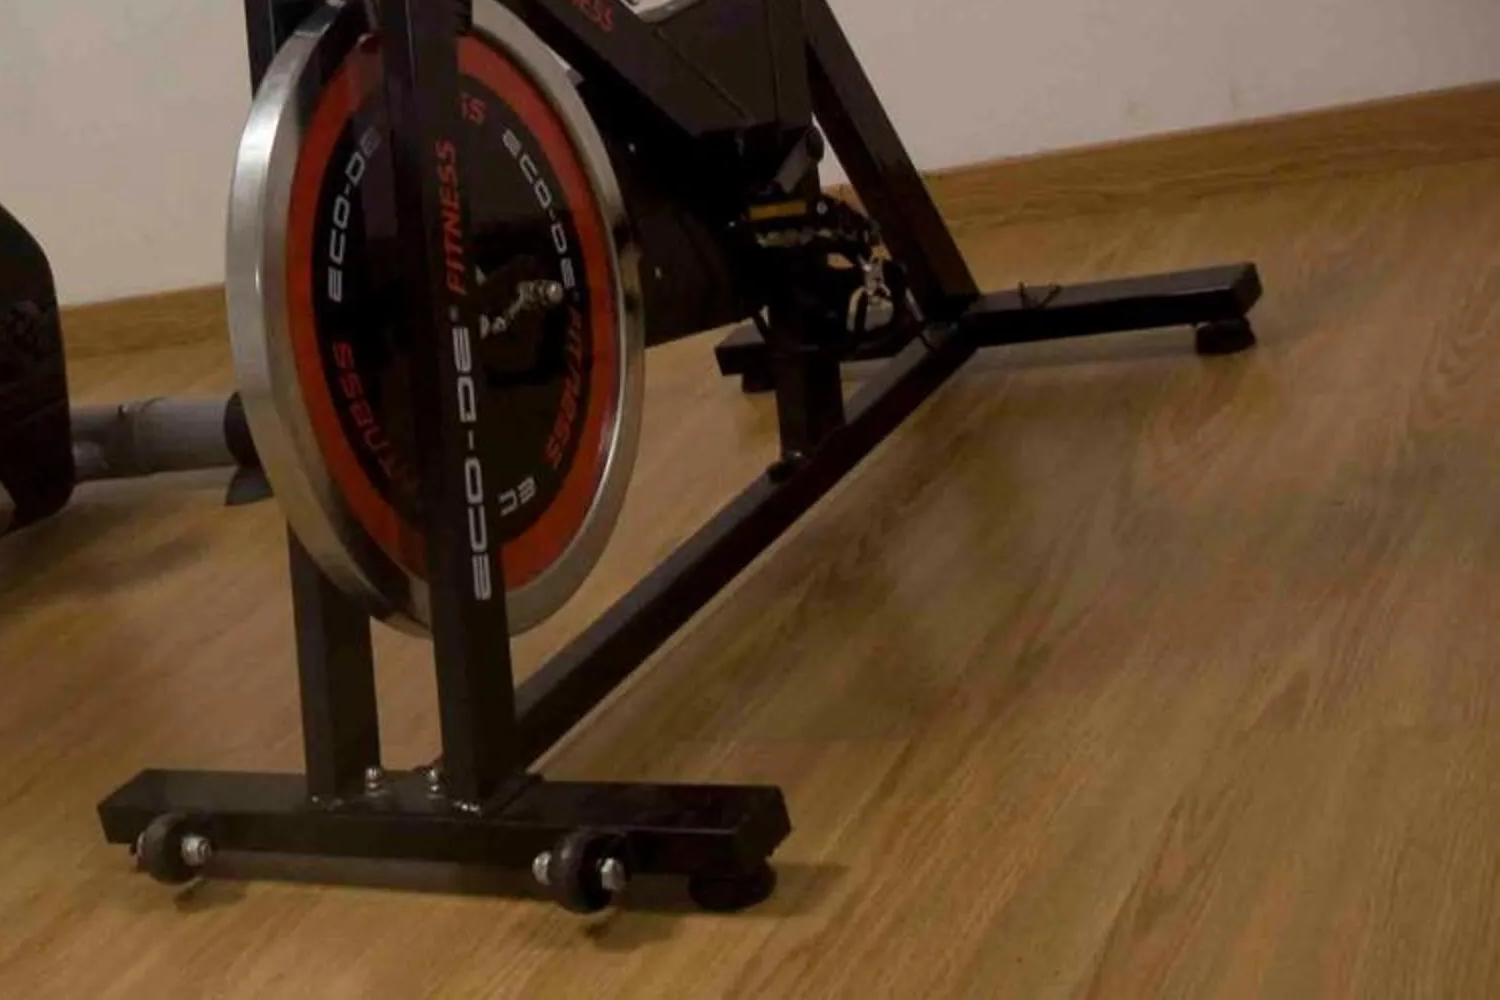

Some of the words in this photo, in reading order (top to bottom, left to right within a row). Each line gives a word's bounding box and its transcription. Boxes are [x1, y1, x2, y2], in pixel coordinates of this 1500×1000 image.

[435, 139, 468, 297] FITNESS
[502, 127, 577, 289] ECO-DE
[451, 326, 492, 601] ECO-DE
